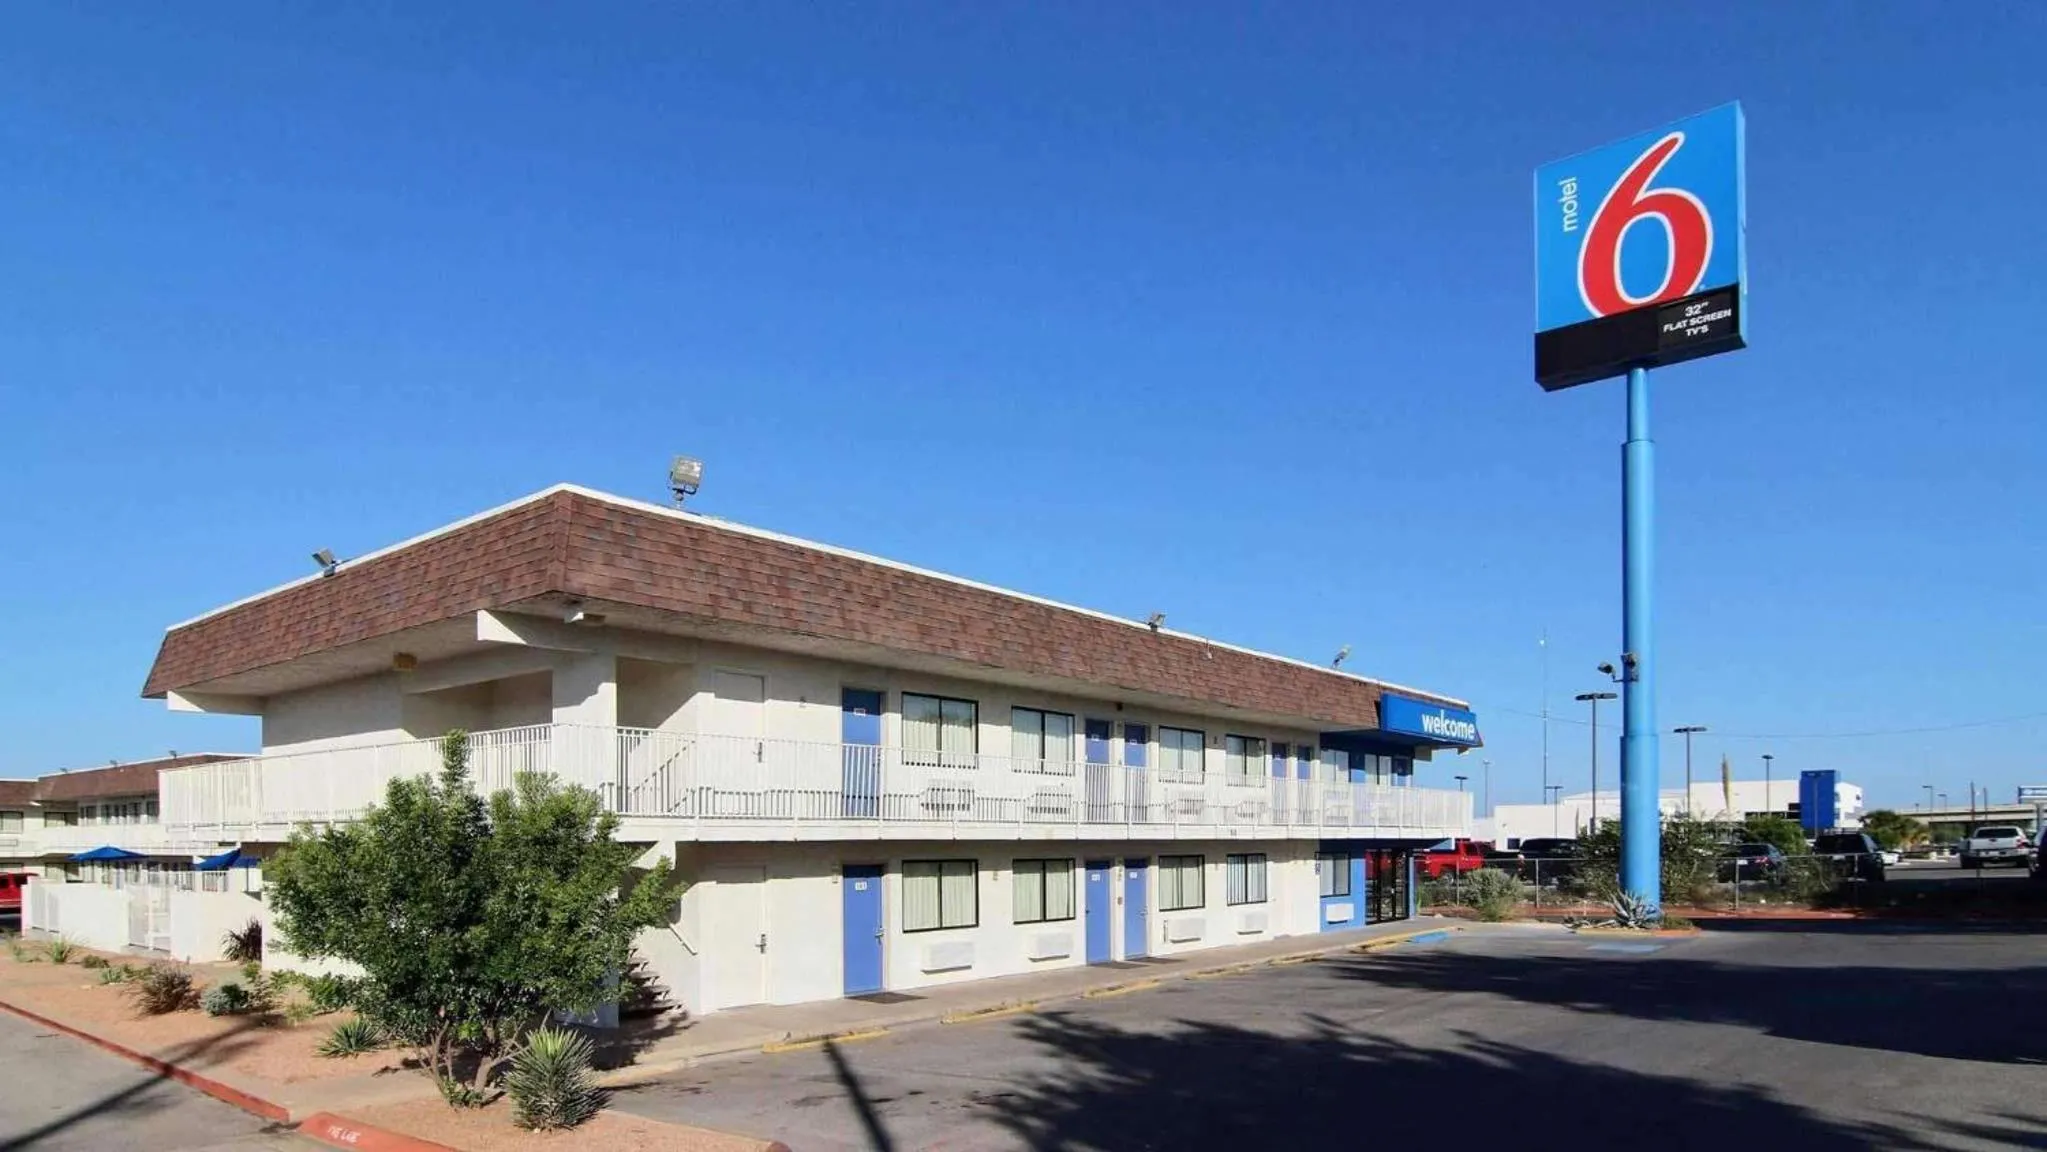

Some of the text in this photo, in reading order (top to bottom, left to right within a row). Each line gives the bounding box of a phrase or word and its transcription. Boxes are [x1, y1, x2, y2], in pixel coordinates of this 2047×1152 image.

[1557, 177, 1578, 232] motel
[1577, 131, 1713, 317] 6
[1664, 308, 1732, 333] FLAT SCREEN
[1686, 325, 1709, 336] TV'S
[1422, 709, 1475, 740] welcome
